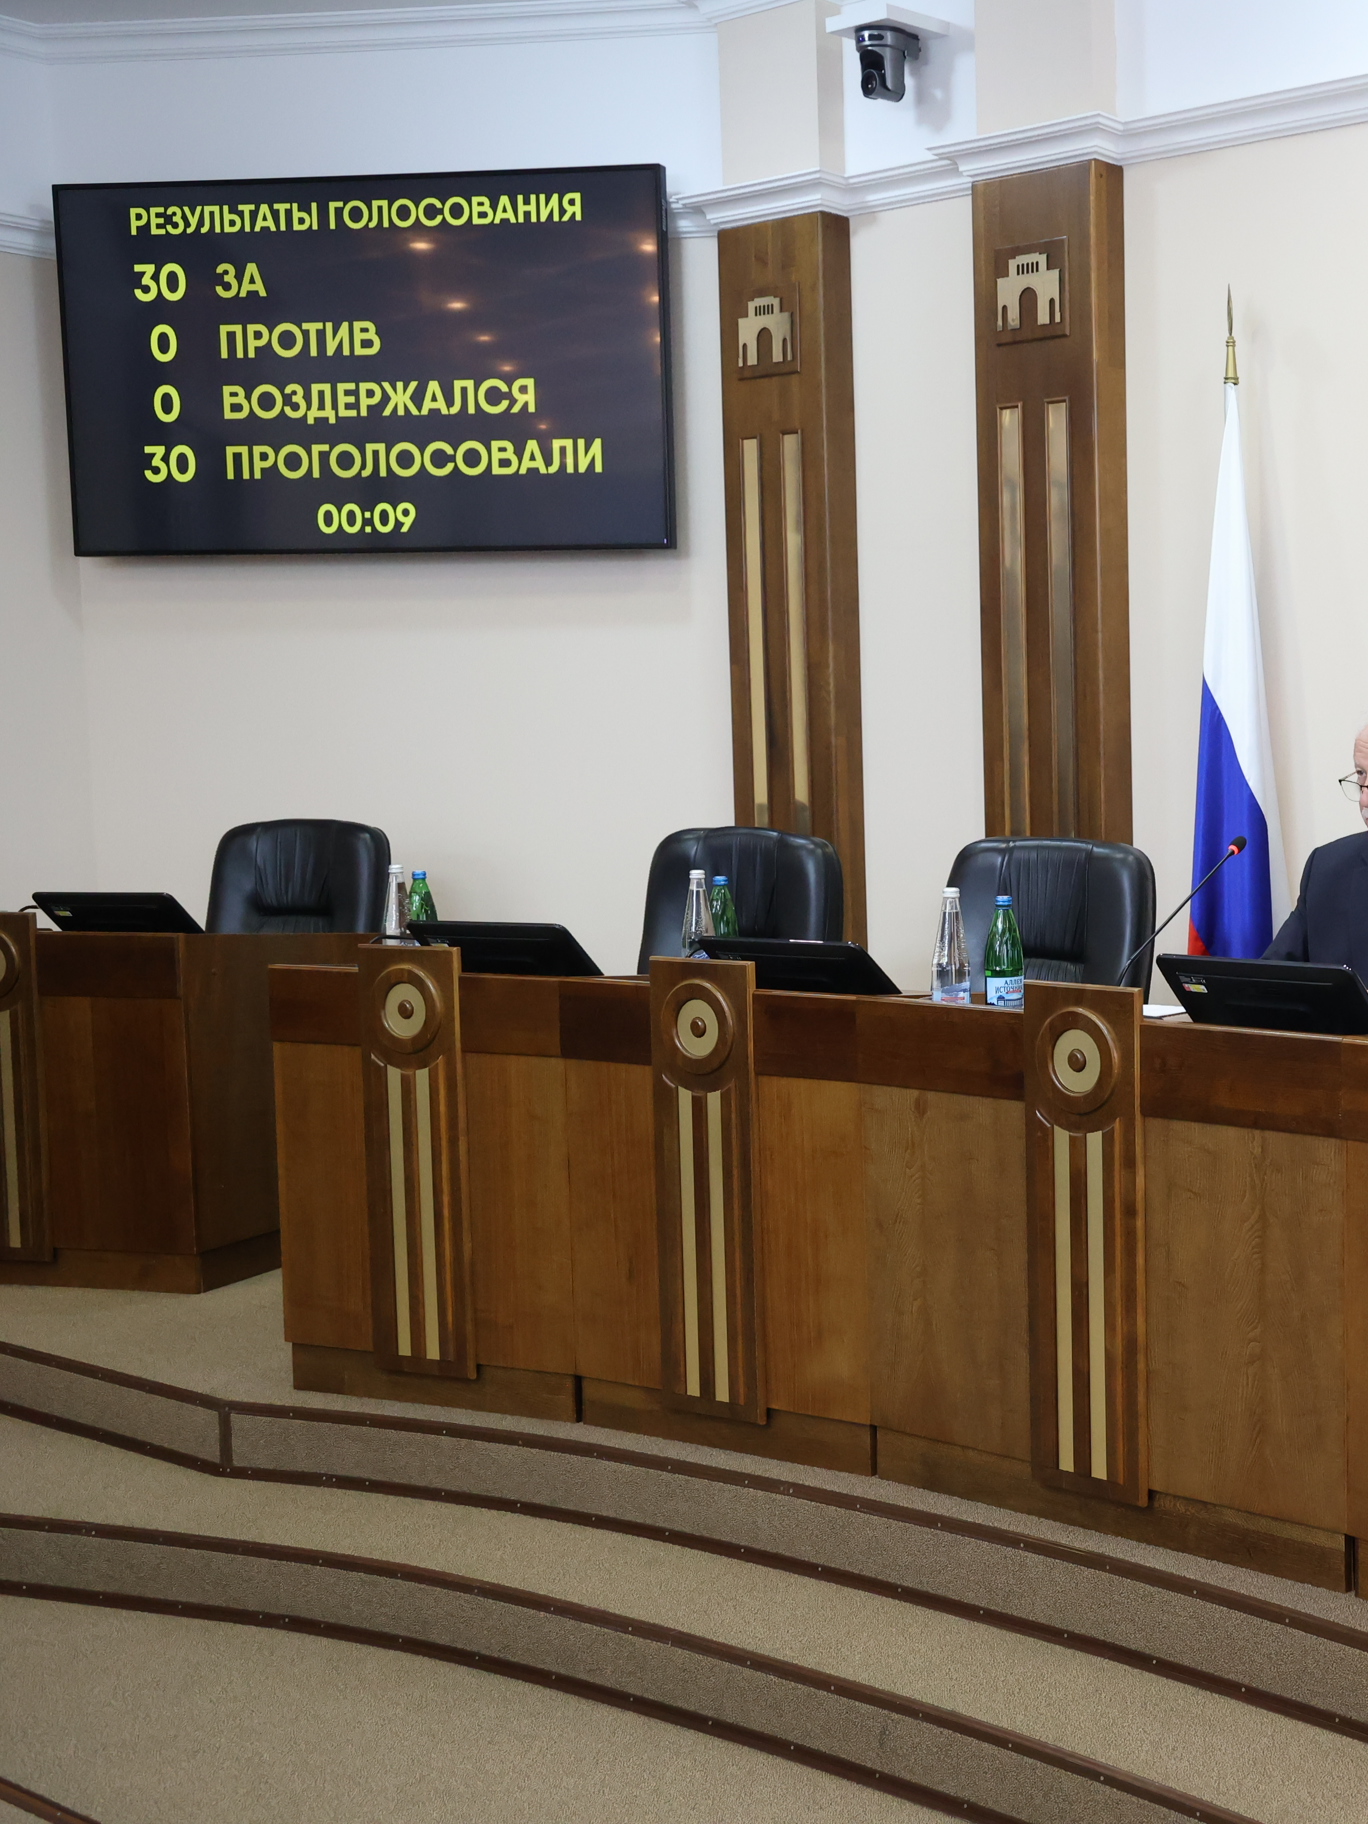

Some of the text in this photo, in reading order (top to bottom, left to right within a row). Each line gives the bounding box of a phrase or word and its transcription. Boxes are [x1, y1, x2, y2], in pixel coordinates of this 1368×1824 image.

[129, 191, 583, 236] РЕЗУЛЬТАТЫ ГОЛОСОВАНИЯ
[133, 262, 268, 303] 30 ЗА
[150, 320, 382, 363] 0 ПРОТИВ
[153, 377, 537, 425] 0 ВОЗДЕРЖАЛСЯ
[143, 437, 604, 483] 30 ПРОГОЛОСОВАЛИ
[316, 501, 417, 535] 00:09
